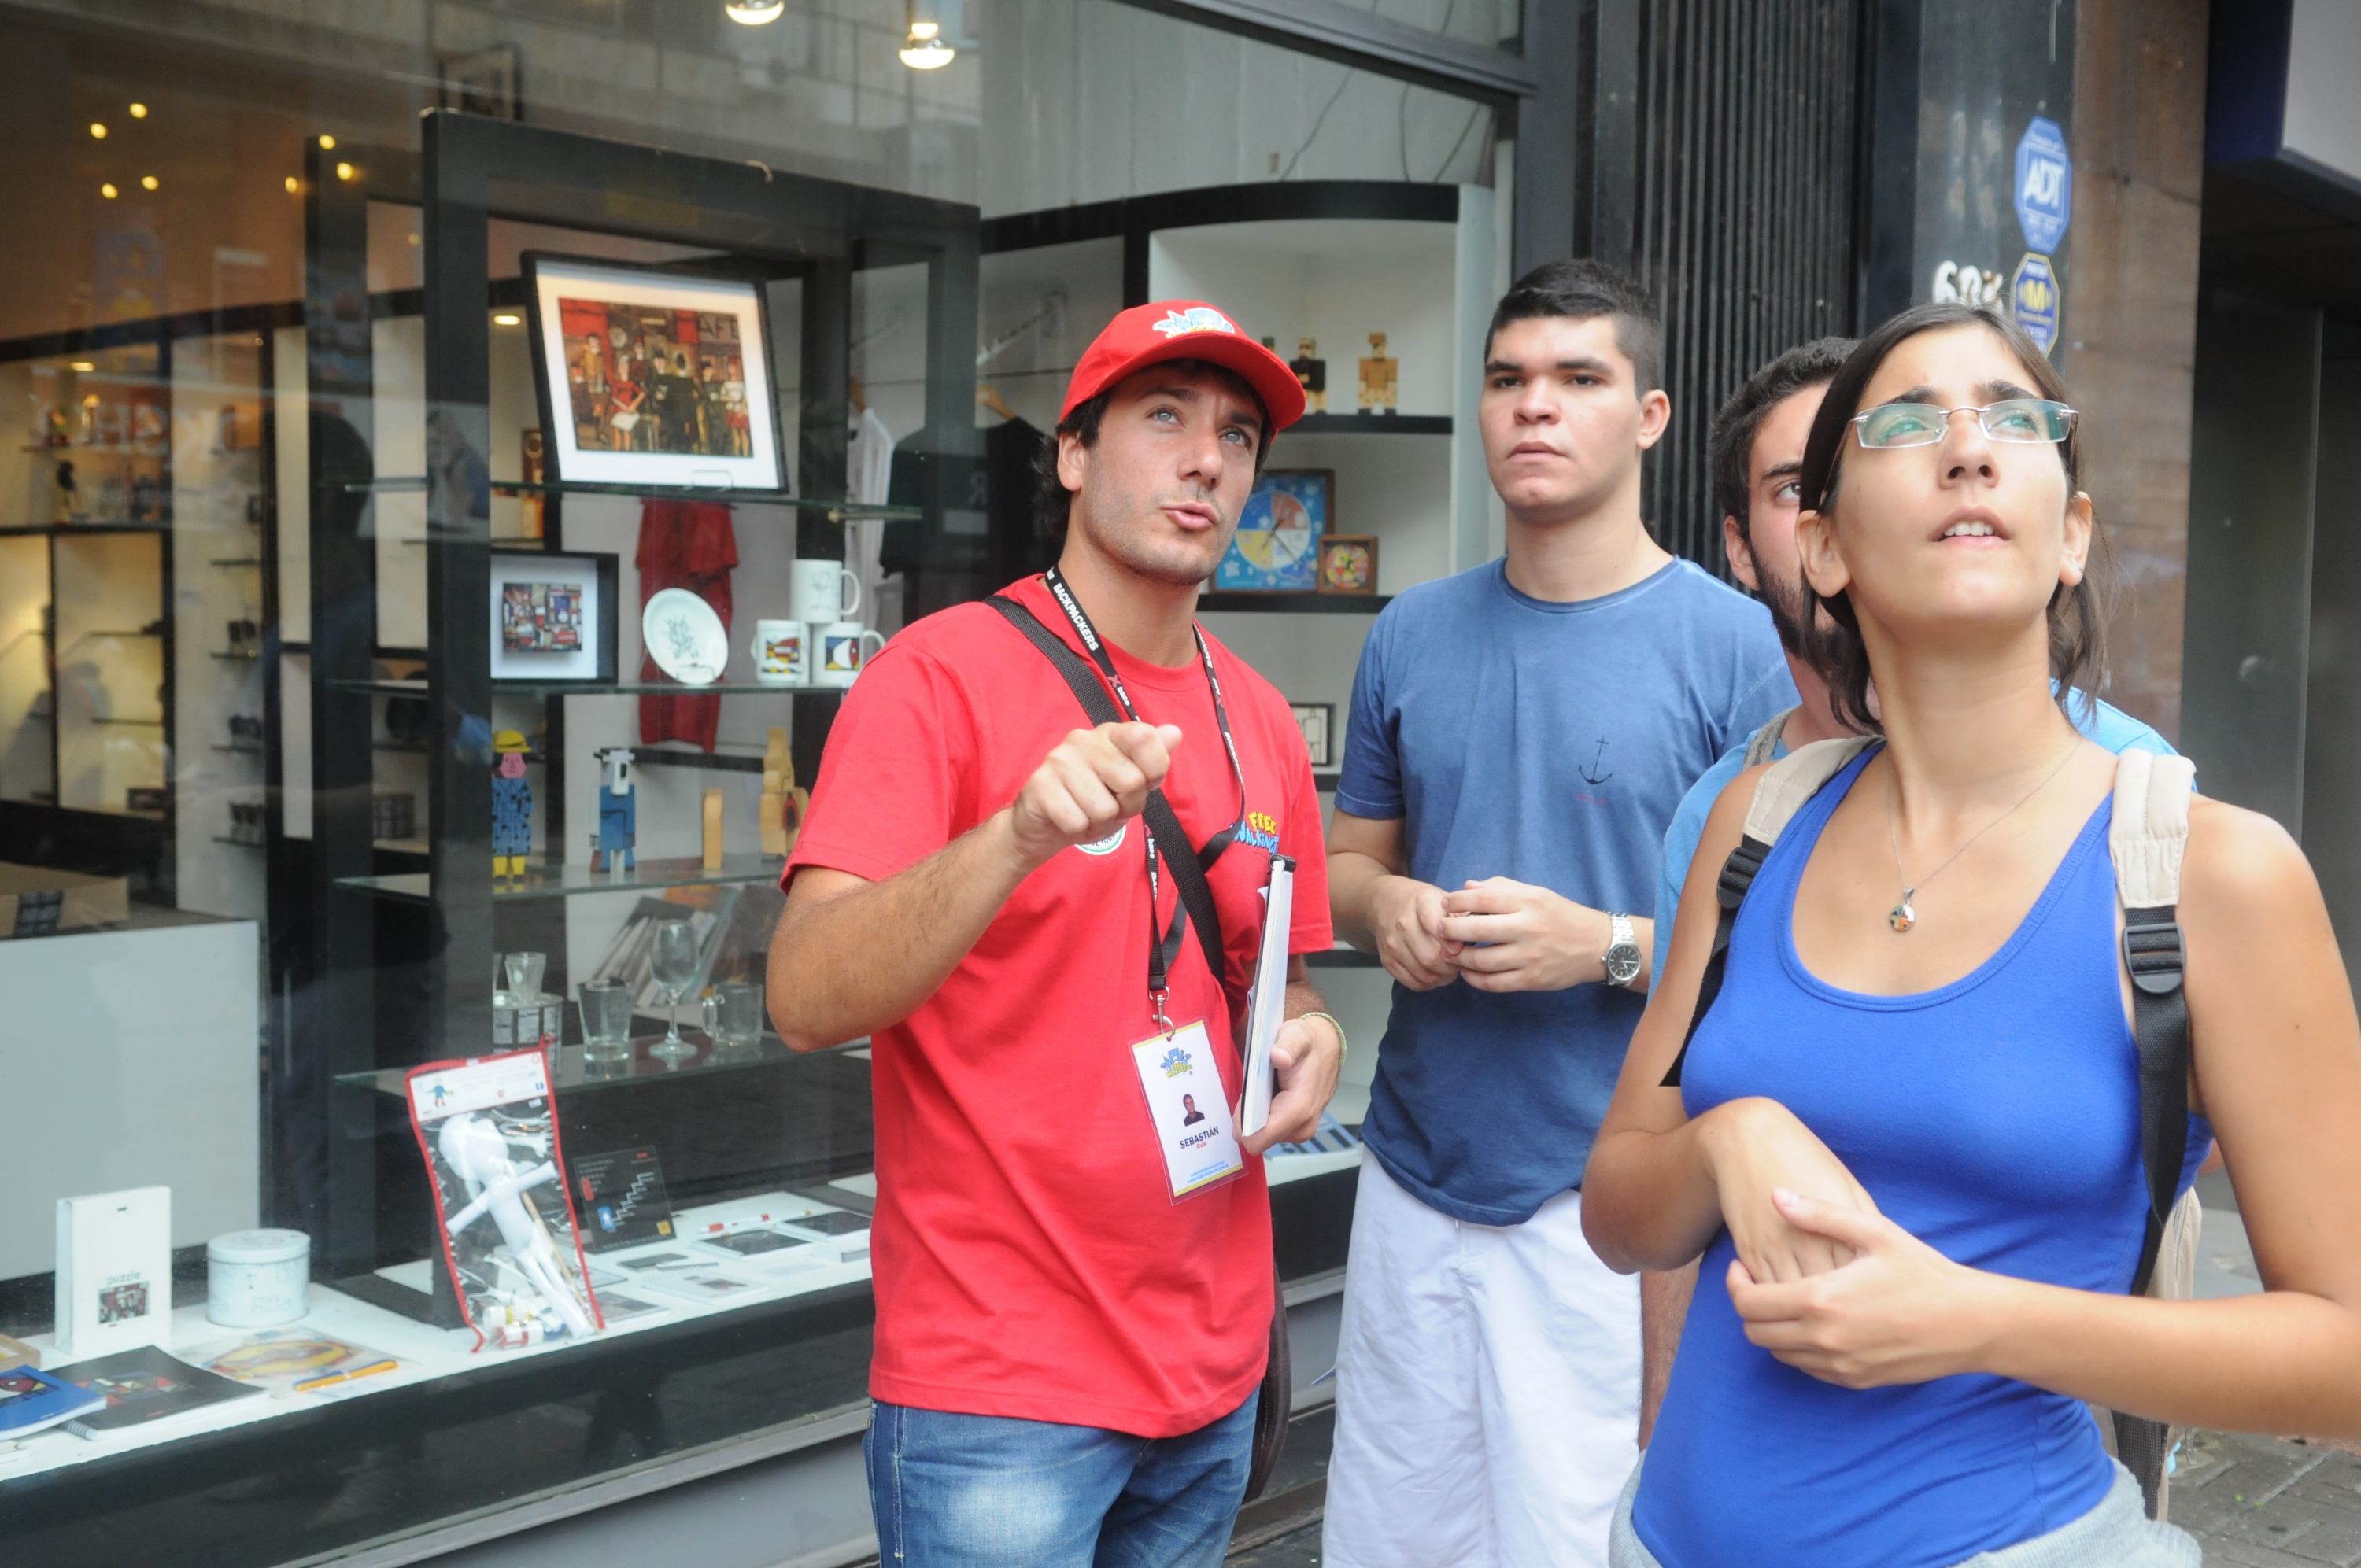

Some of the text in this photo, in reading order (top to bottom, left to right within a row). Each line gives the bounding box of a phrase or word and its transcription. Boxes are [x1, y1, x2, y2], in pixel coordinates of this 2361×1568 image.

[2023, 159, 2063, 208] ADT
[1053, 582, 1099, 651] BACKPACKERS
[1248, 810, 1277, 836] FREE
[1180, 1127, 1219, 1149] SEBASTIÁN
[106, 1271, 141, 1285] puzzle
